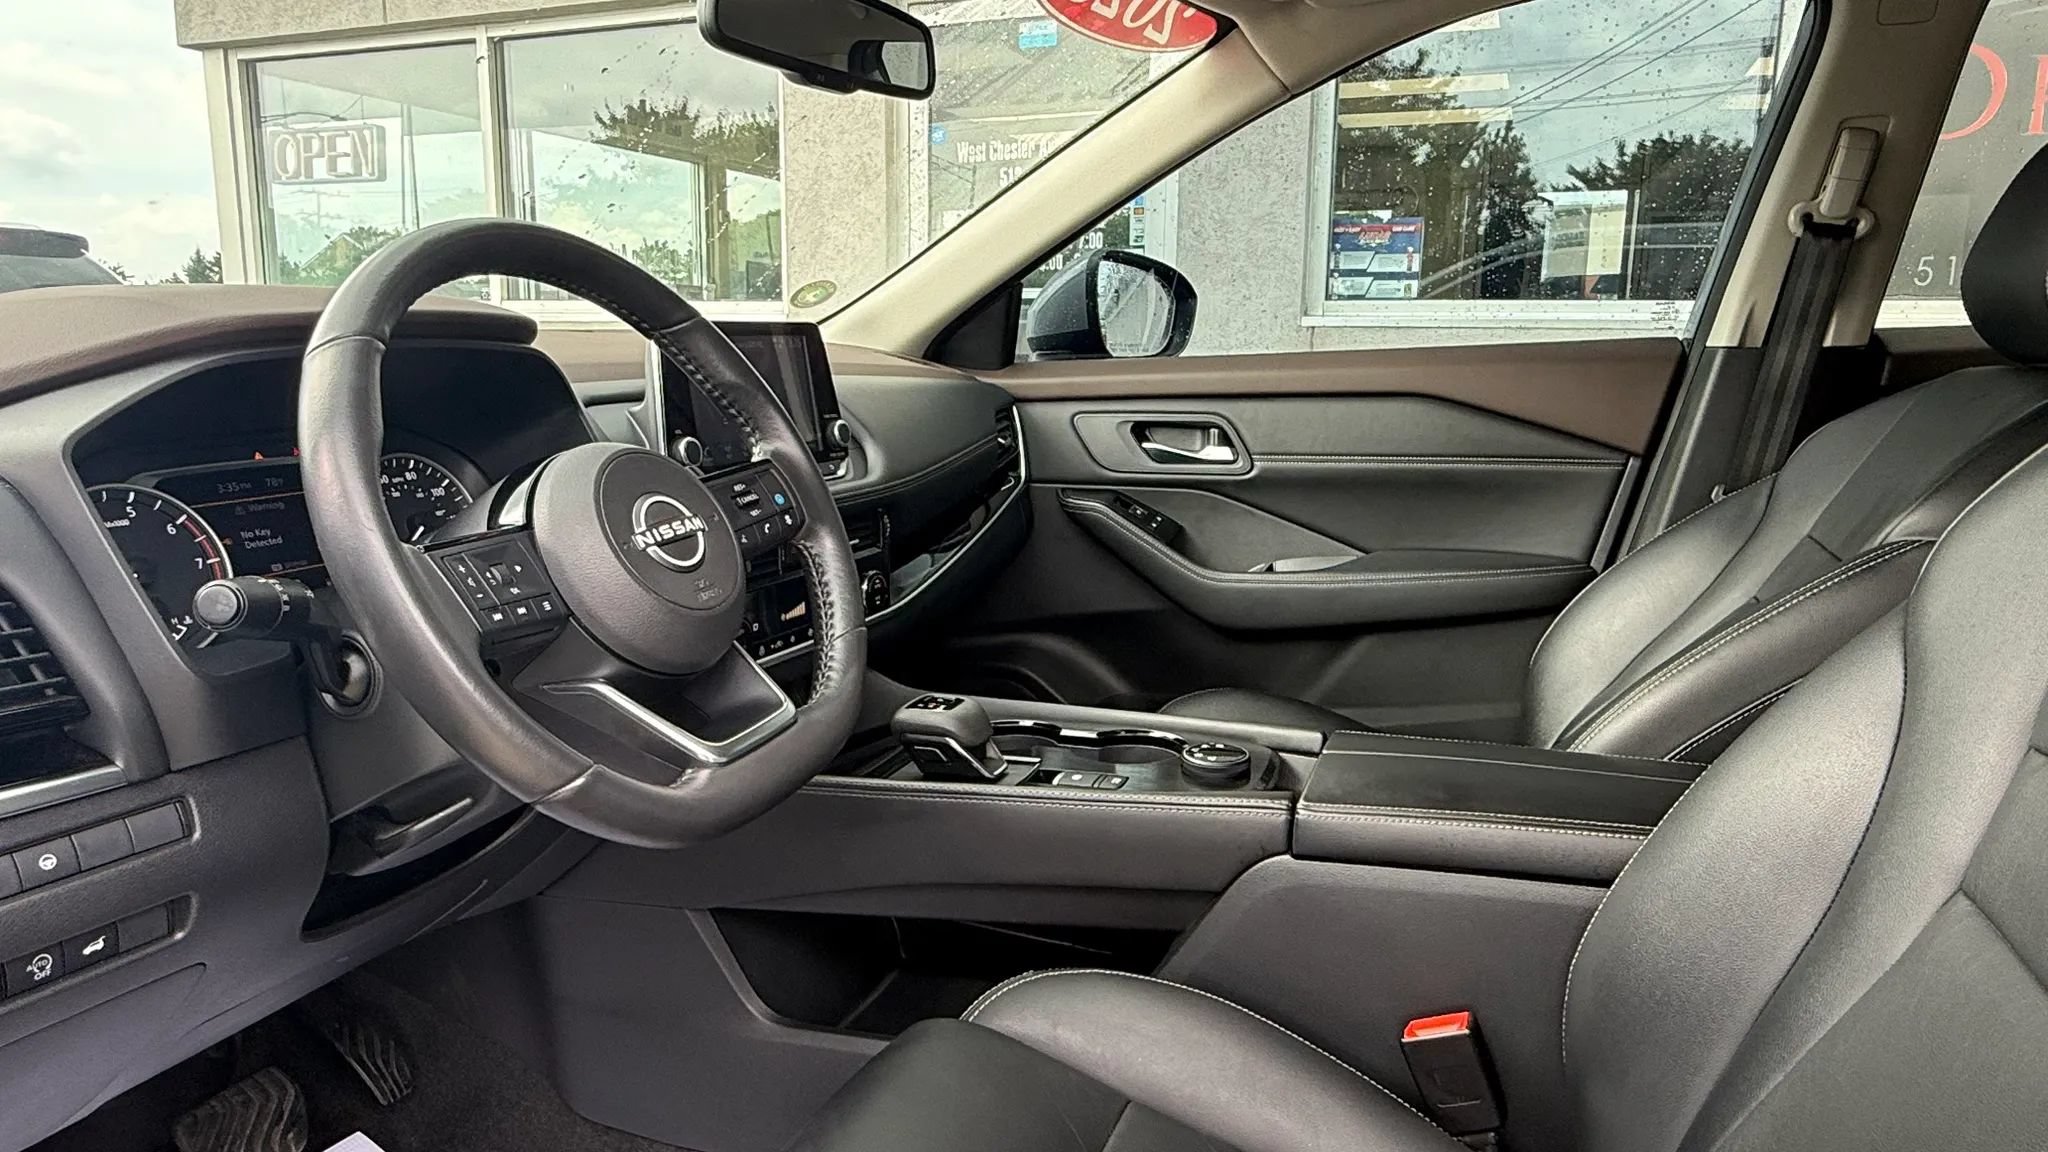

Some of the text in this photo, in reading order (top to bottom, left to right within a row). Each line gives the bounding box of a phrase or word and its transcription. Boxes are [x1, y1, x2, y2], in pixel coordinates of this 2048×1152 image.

[273, 128, 376, 182] OPEN
[957, 141, 986, 164] West
[988, 139, 1036, 162] Chester
[405, 471, 417, 481] 80
[431, 486, 446, 497] 100
[126, 506, 136, 518] 5
[248, 501, 285, 512] Warning
[166, 523, 177, 535] 6
[240, 527, 271, 539] No Key
[635, 516, 704, 549] NISSAN
[244, 536, 284, 550] Detected
[194, 557, 203, 570] 7
[25, 959, 49, 973] AUTO
[33, 968, 52, 981] OFF
